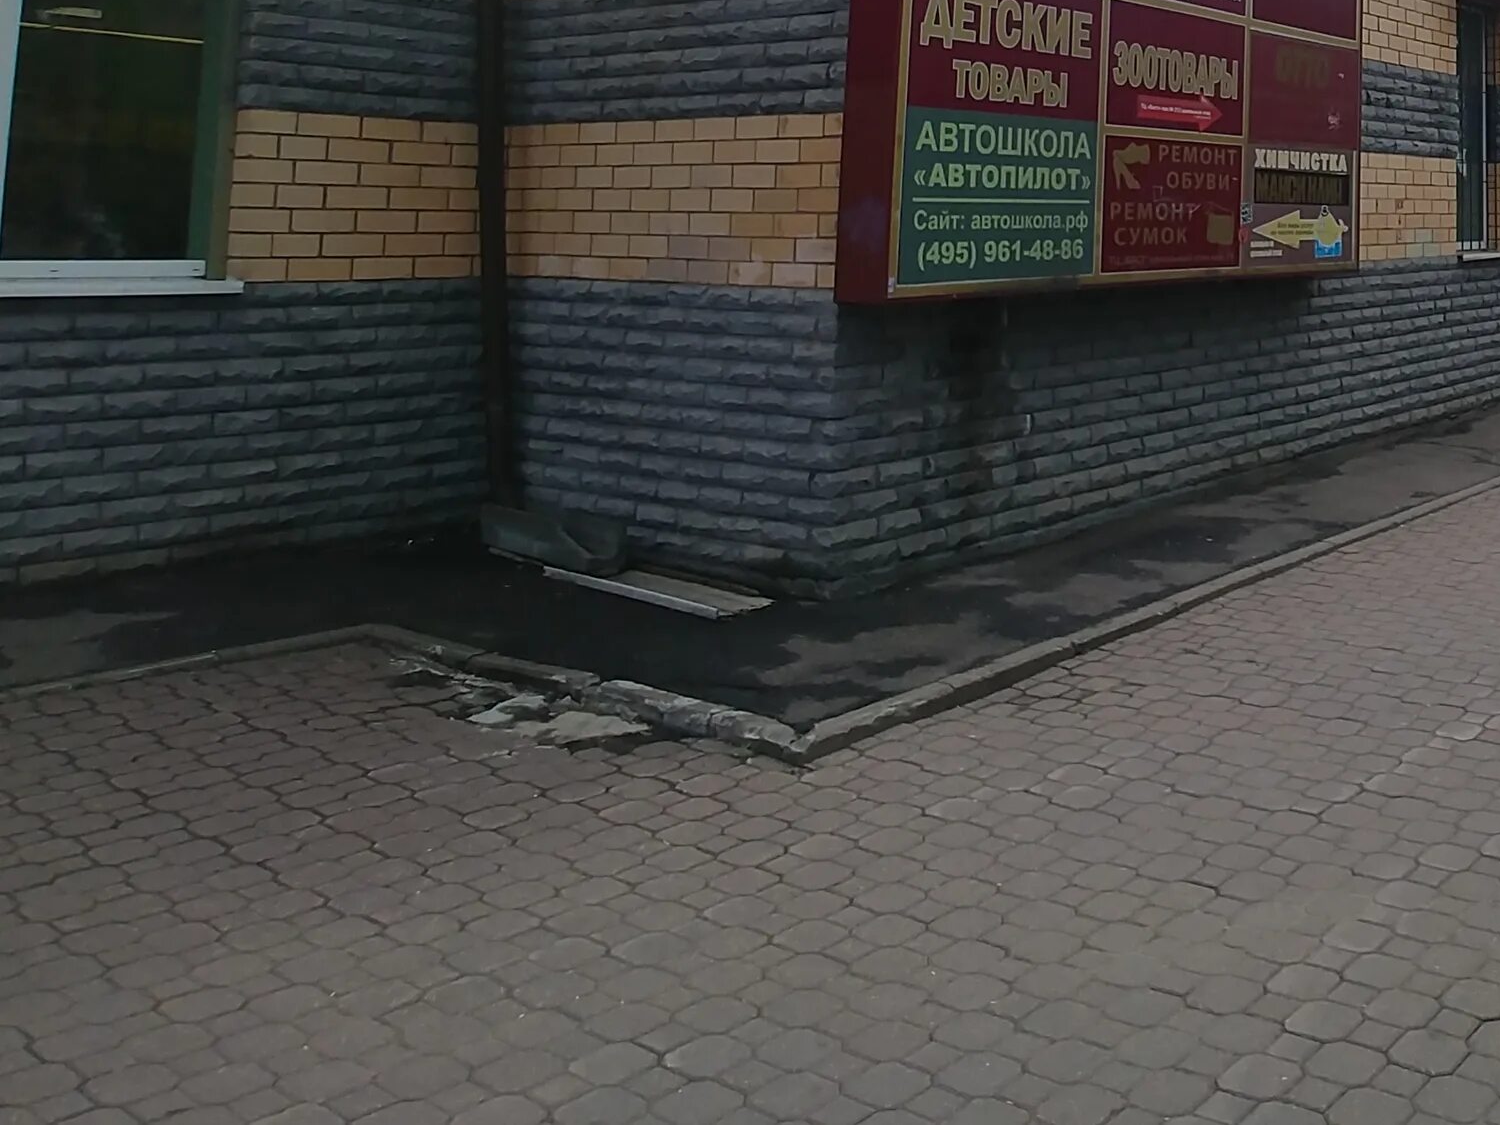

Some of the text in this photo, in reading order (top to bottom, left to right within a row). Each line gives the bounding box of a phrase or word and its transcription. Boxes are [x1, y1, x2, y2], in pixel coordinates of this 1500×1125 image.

[1113, 40, 1239, 100] ЗООТОВАРЫ
[952, 59, 1068, 108] ТОВАРЫ
[915, 120, 1091, 159] АВТОШКОЛА
[1159, 144, 1238, 165] РЕМОНТ
[1254, 148, 1348, 172] ХИМЧИСТКА
[914, 162, 1091, 191] «АВТОПИЛОТ»
[1166, 171, 1230, 191] ОБУВИ
[913, 209, 1088, 233] Сайт: автошкола.рф
[1110, 202, 1195, 221] РЕМОНТ
[1114, 227, 1188, 246] СУМОК
[917, 240, 977, 271] (495)
[984, 239, 1083, 263] 961-48-86
